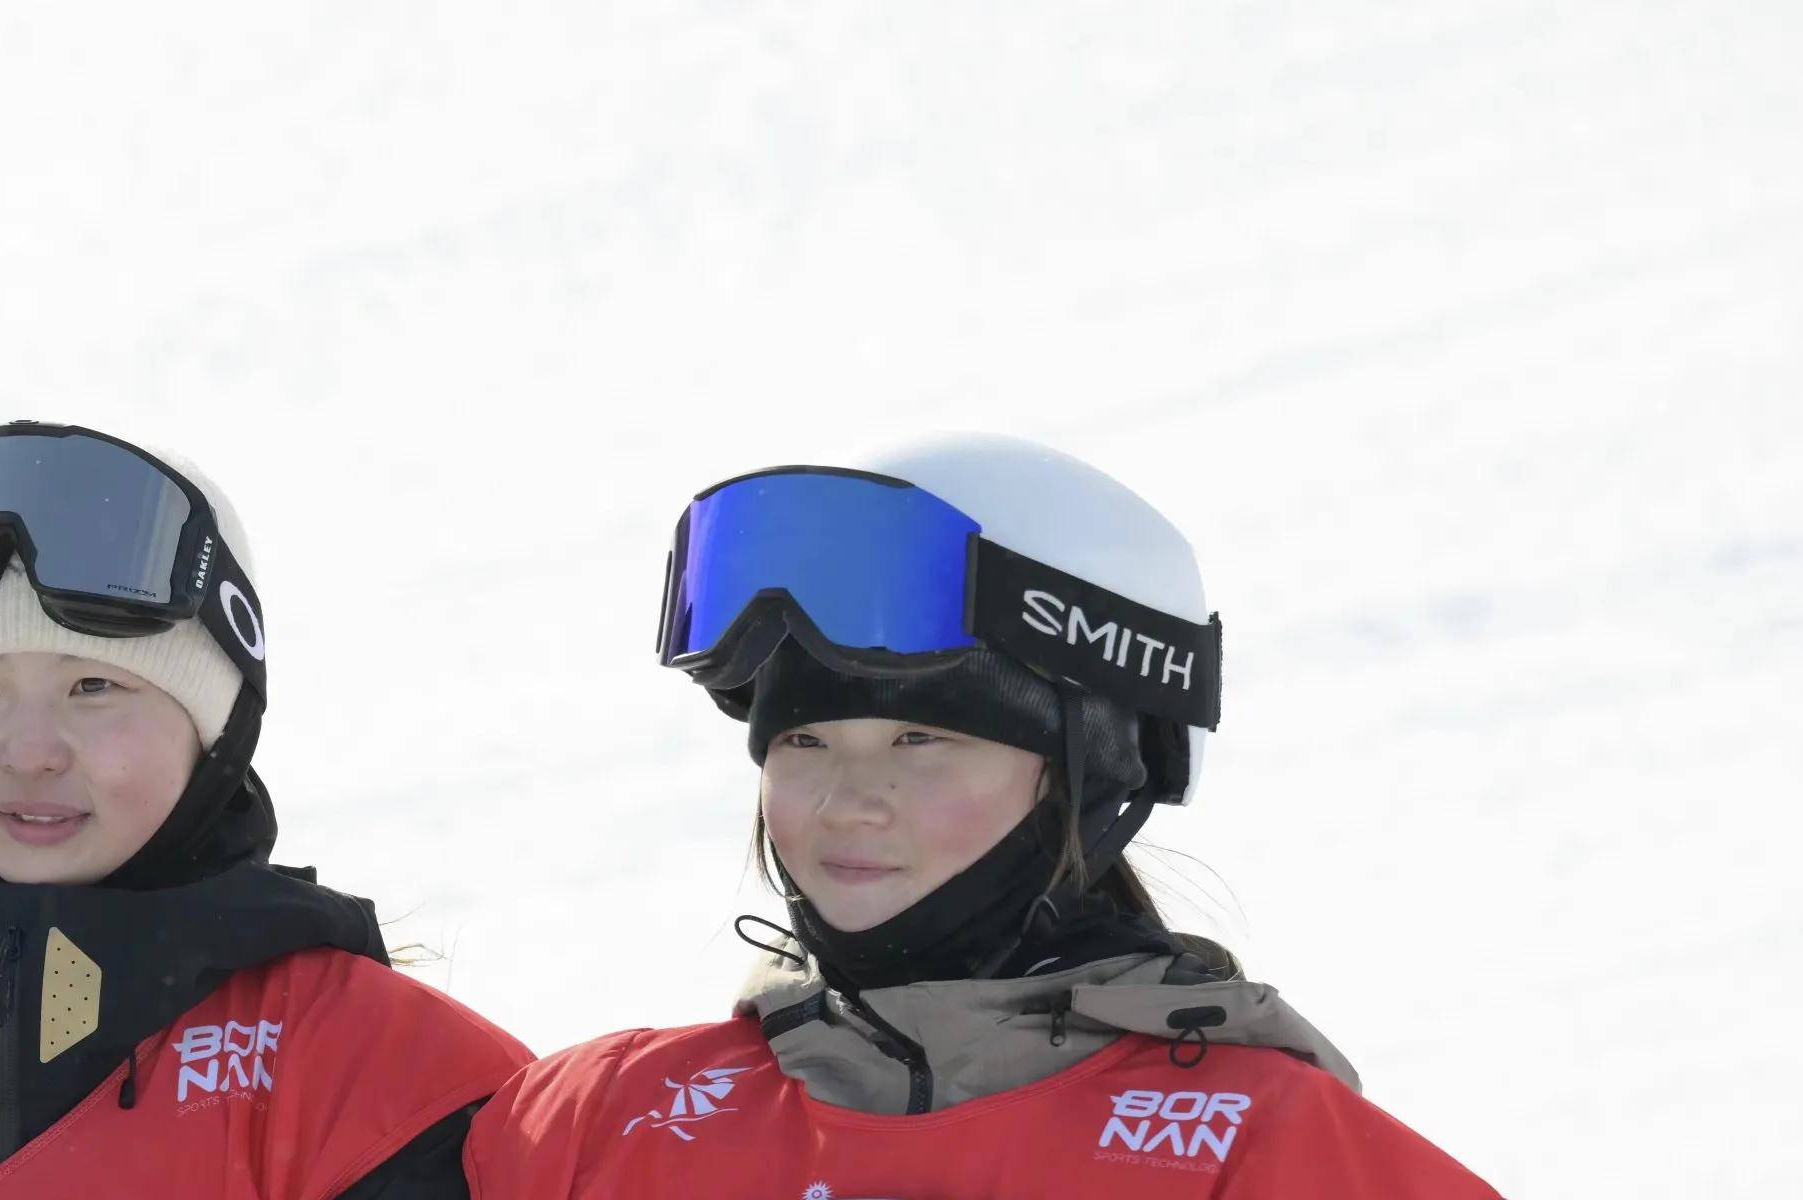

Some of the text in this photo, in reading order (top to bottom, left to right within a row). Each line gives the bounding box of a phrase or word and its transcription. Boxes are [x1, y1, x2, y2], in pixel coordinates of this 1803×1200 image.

[195, 535, 214, 589] OAKLEY
[1021, 589, 1195, 691] SMITH
[1109, 1089, 1252, 1125] BOR
[1098, 1116, 1238, 1163] NAN
